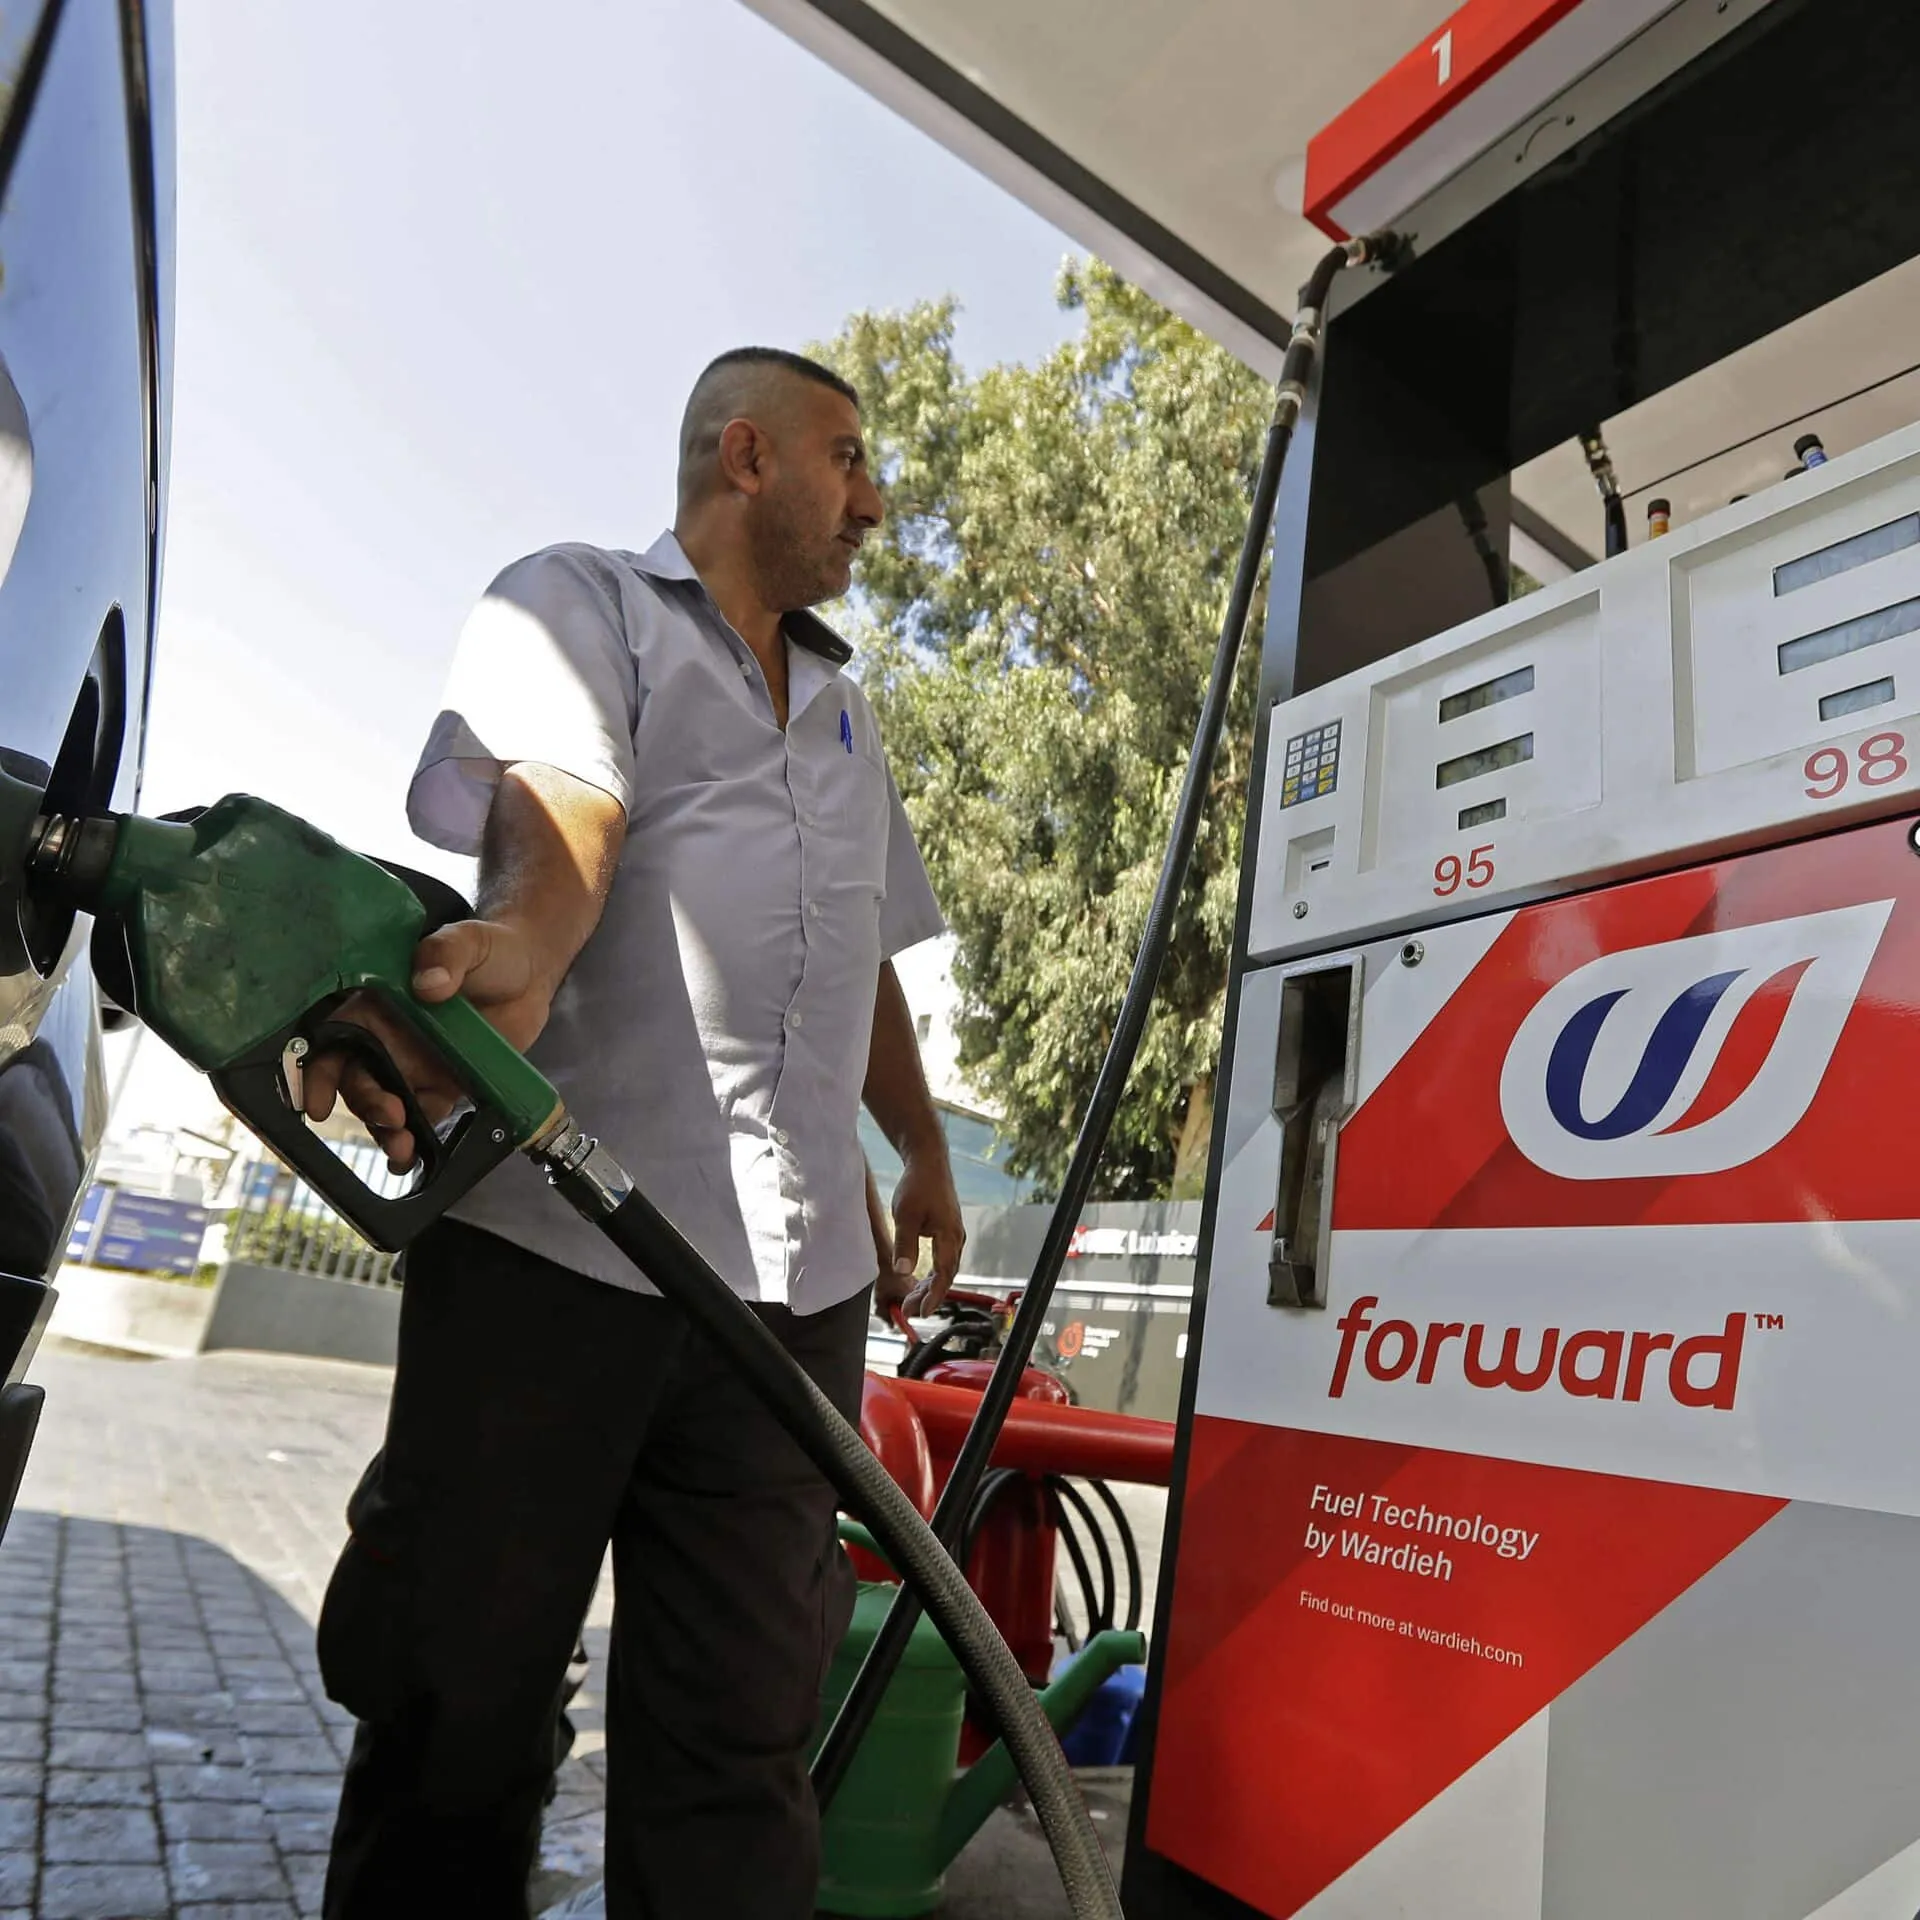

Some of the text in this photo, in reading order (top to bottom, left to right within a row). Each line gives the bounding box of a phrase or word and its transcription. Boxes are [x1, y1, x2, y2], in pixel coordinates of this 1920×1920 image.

[1431, 29, 1452, 86] 1
[1803, 731, 1908, 800] 98
[1433, 843, 1496, 897] 95
[1327, 1296, 1747, 1411] forward
[1303, 1522, 1454, 1581] by Wardieh
[1309, 1484, 1540, 1561] Fuel Technology
[1299, 1590, 1524, 1668] Find out more at wardieh.com
